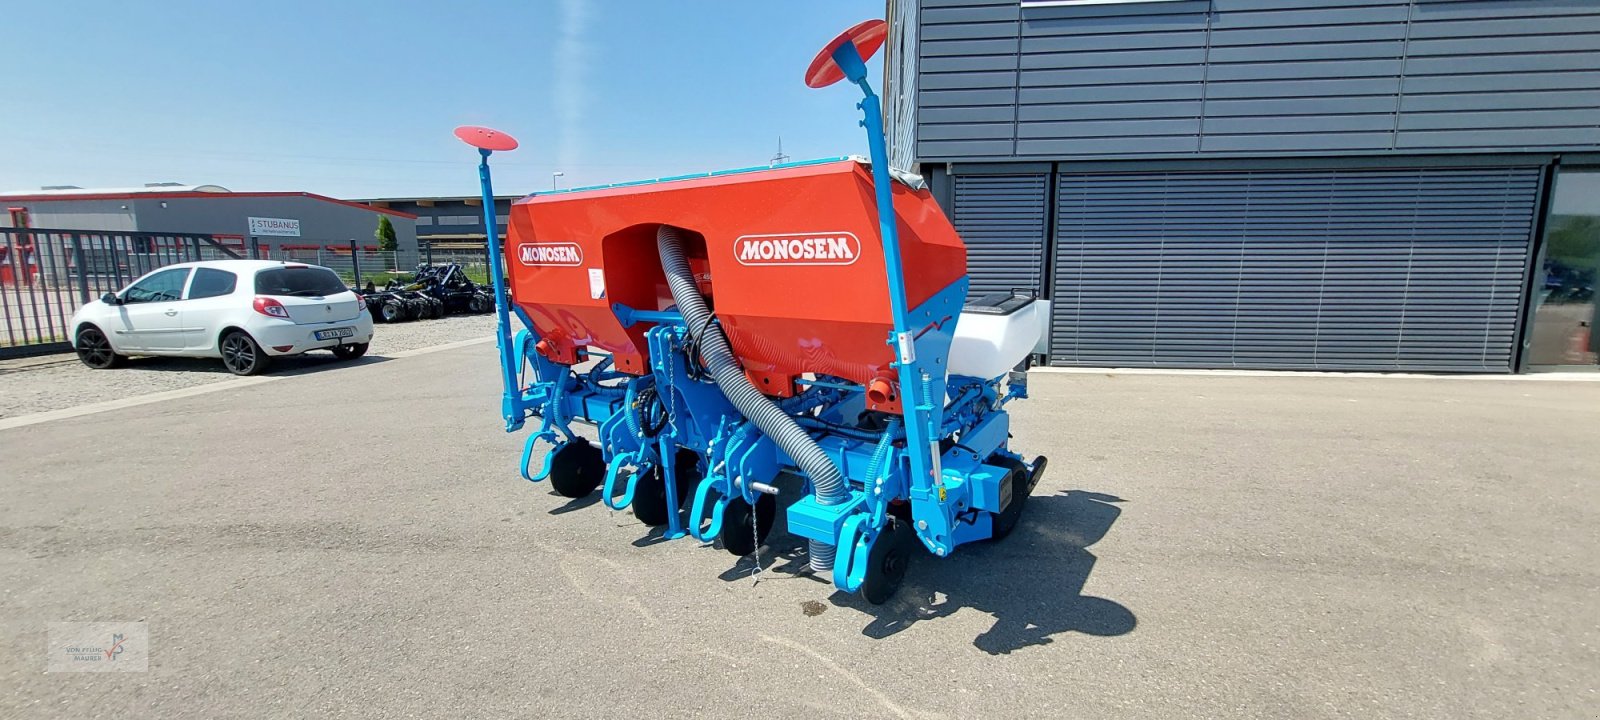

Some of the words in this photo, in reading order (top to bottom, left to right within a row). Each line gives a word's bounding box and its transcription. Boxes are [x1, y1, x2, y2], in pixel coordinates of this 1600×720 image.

[257, 220, 299, 229] STUBANUS
[522, 246, 580, 262] MONOSEM
[740, 238, 853, 260] MONOSEM
